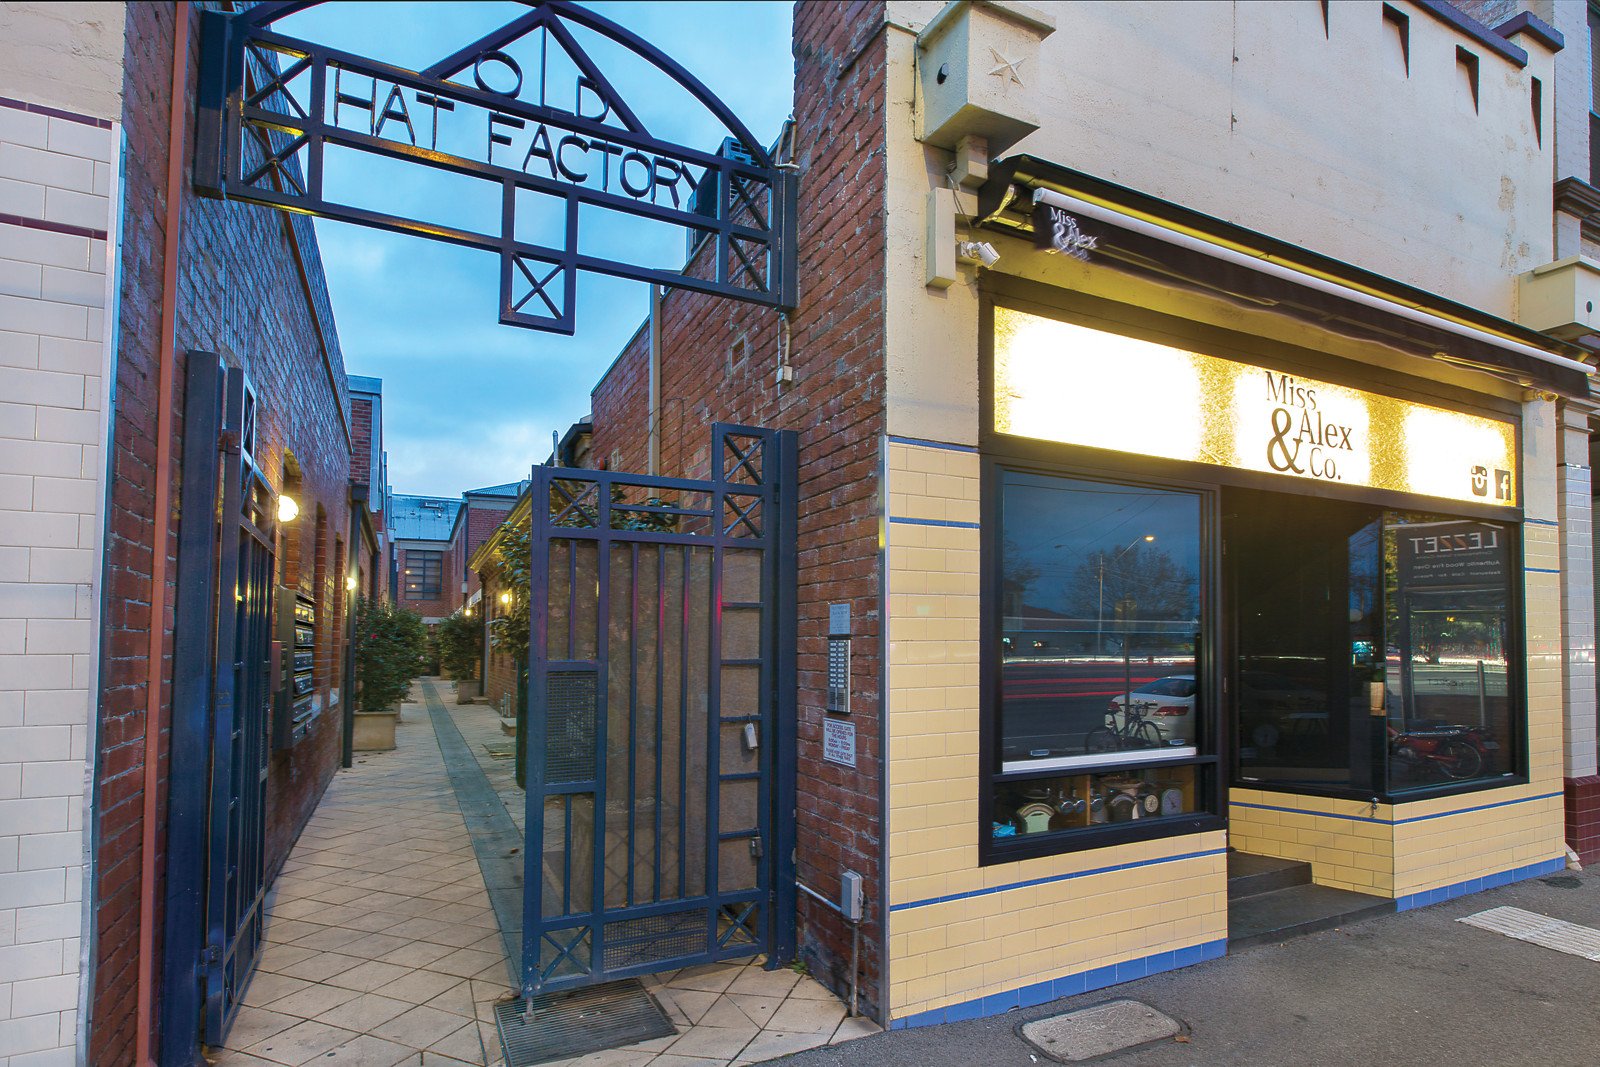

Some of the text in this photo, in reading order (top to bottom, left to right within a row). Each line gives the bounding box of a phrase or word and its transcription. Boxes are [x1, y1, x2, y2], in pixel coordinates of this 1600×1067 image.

[473, 26, 611, 123] OLD
[334, 68, 706, 209] HAT FACTORY
[1050, 206, 1077, 228] Miss
[1067, 225, 1098, 250] Alex
[1264, 370, 1317, 411] Miss
[1266, 407, 1354, 475] & Alex
[1309, 447, 1342, 480] Co.
